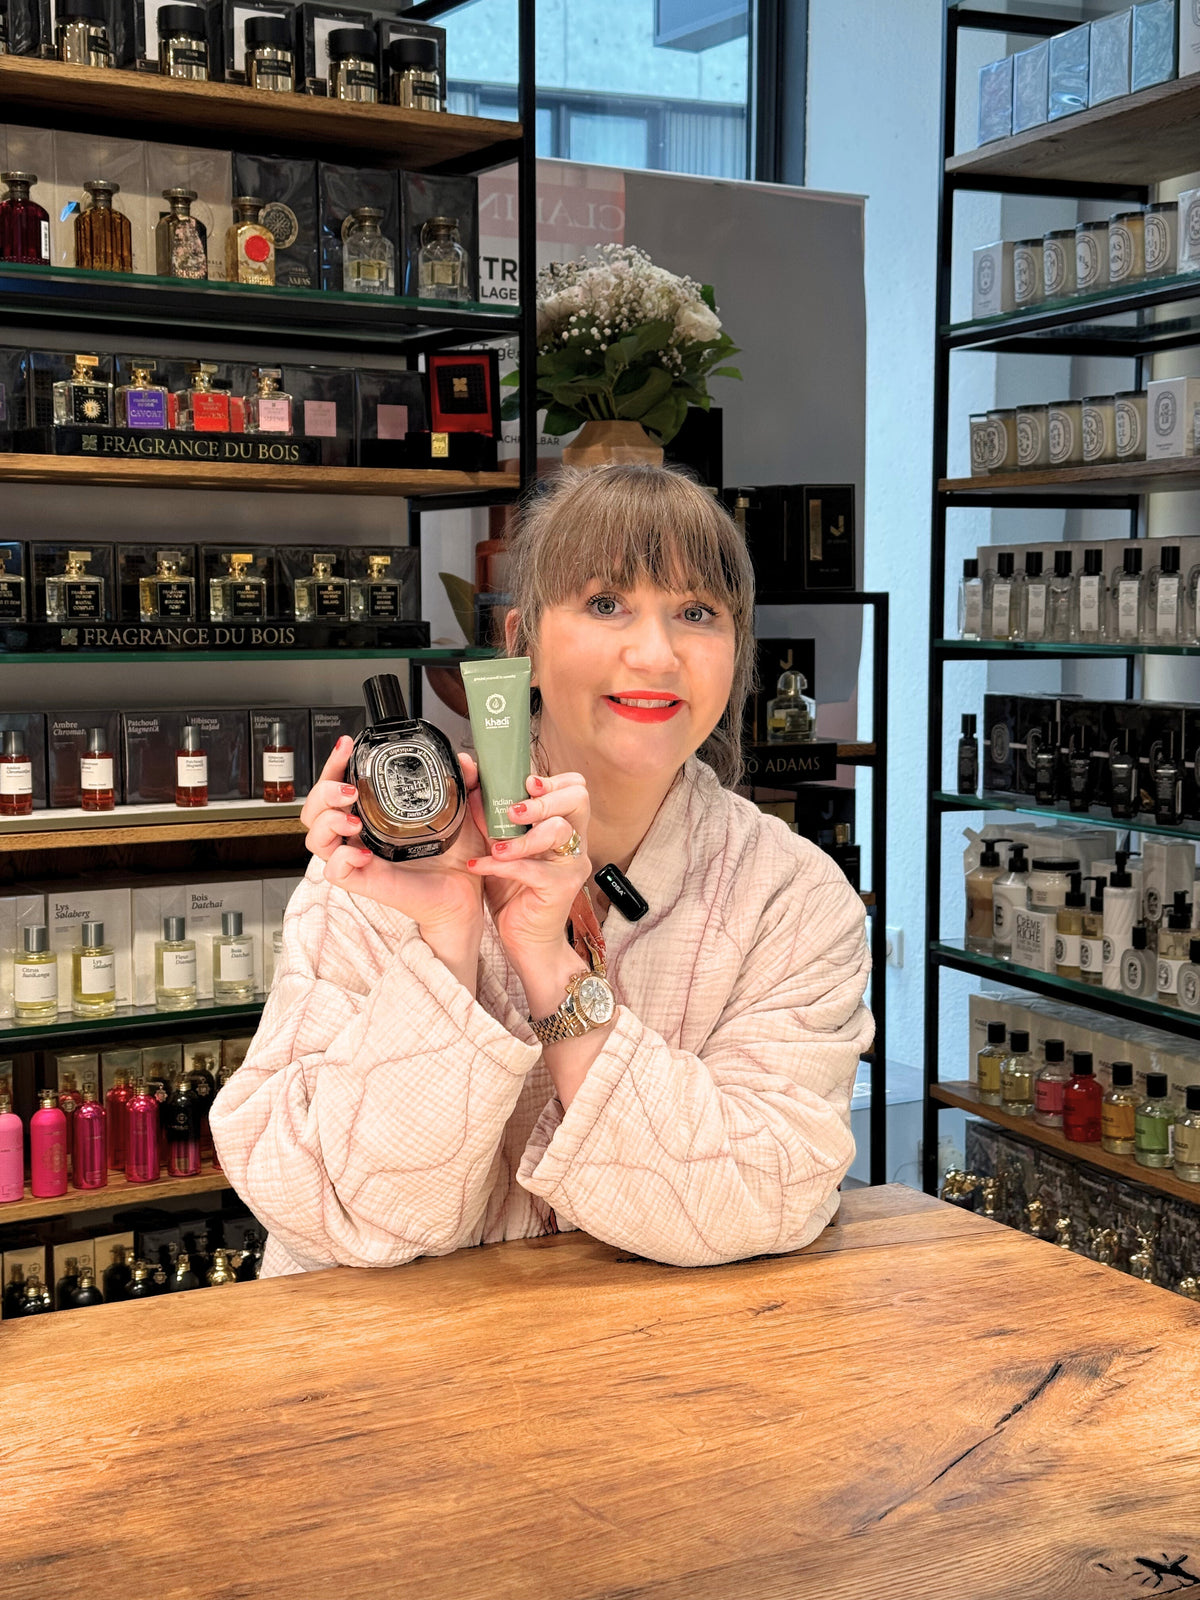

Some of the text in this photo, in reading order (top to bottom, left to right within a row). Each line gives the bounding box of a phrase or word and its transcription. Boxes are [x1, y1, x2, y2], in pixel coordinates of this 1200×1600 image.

[102, 435, 300, 461] FRAGRANCE DU BOIS
[83, 627, 295, 646] FRAGRANCE DU BOIS
[53, 720, 79, 730] Ambre
[765, 756, 821, 773] ADAMS
[492, 797, 514, 806] Indian
[191, 893, 209, 902] Bois
[55, 903, 70, 913] Lys
